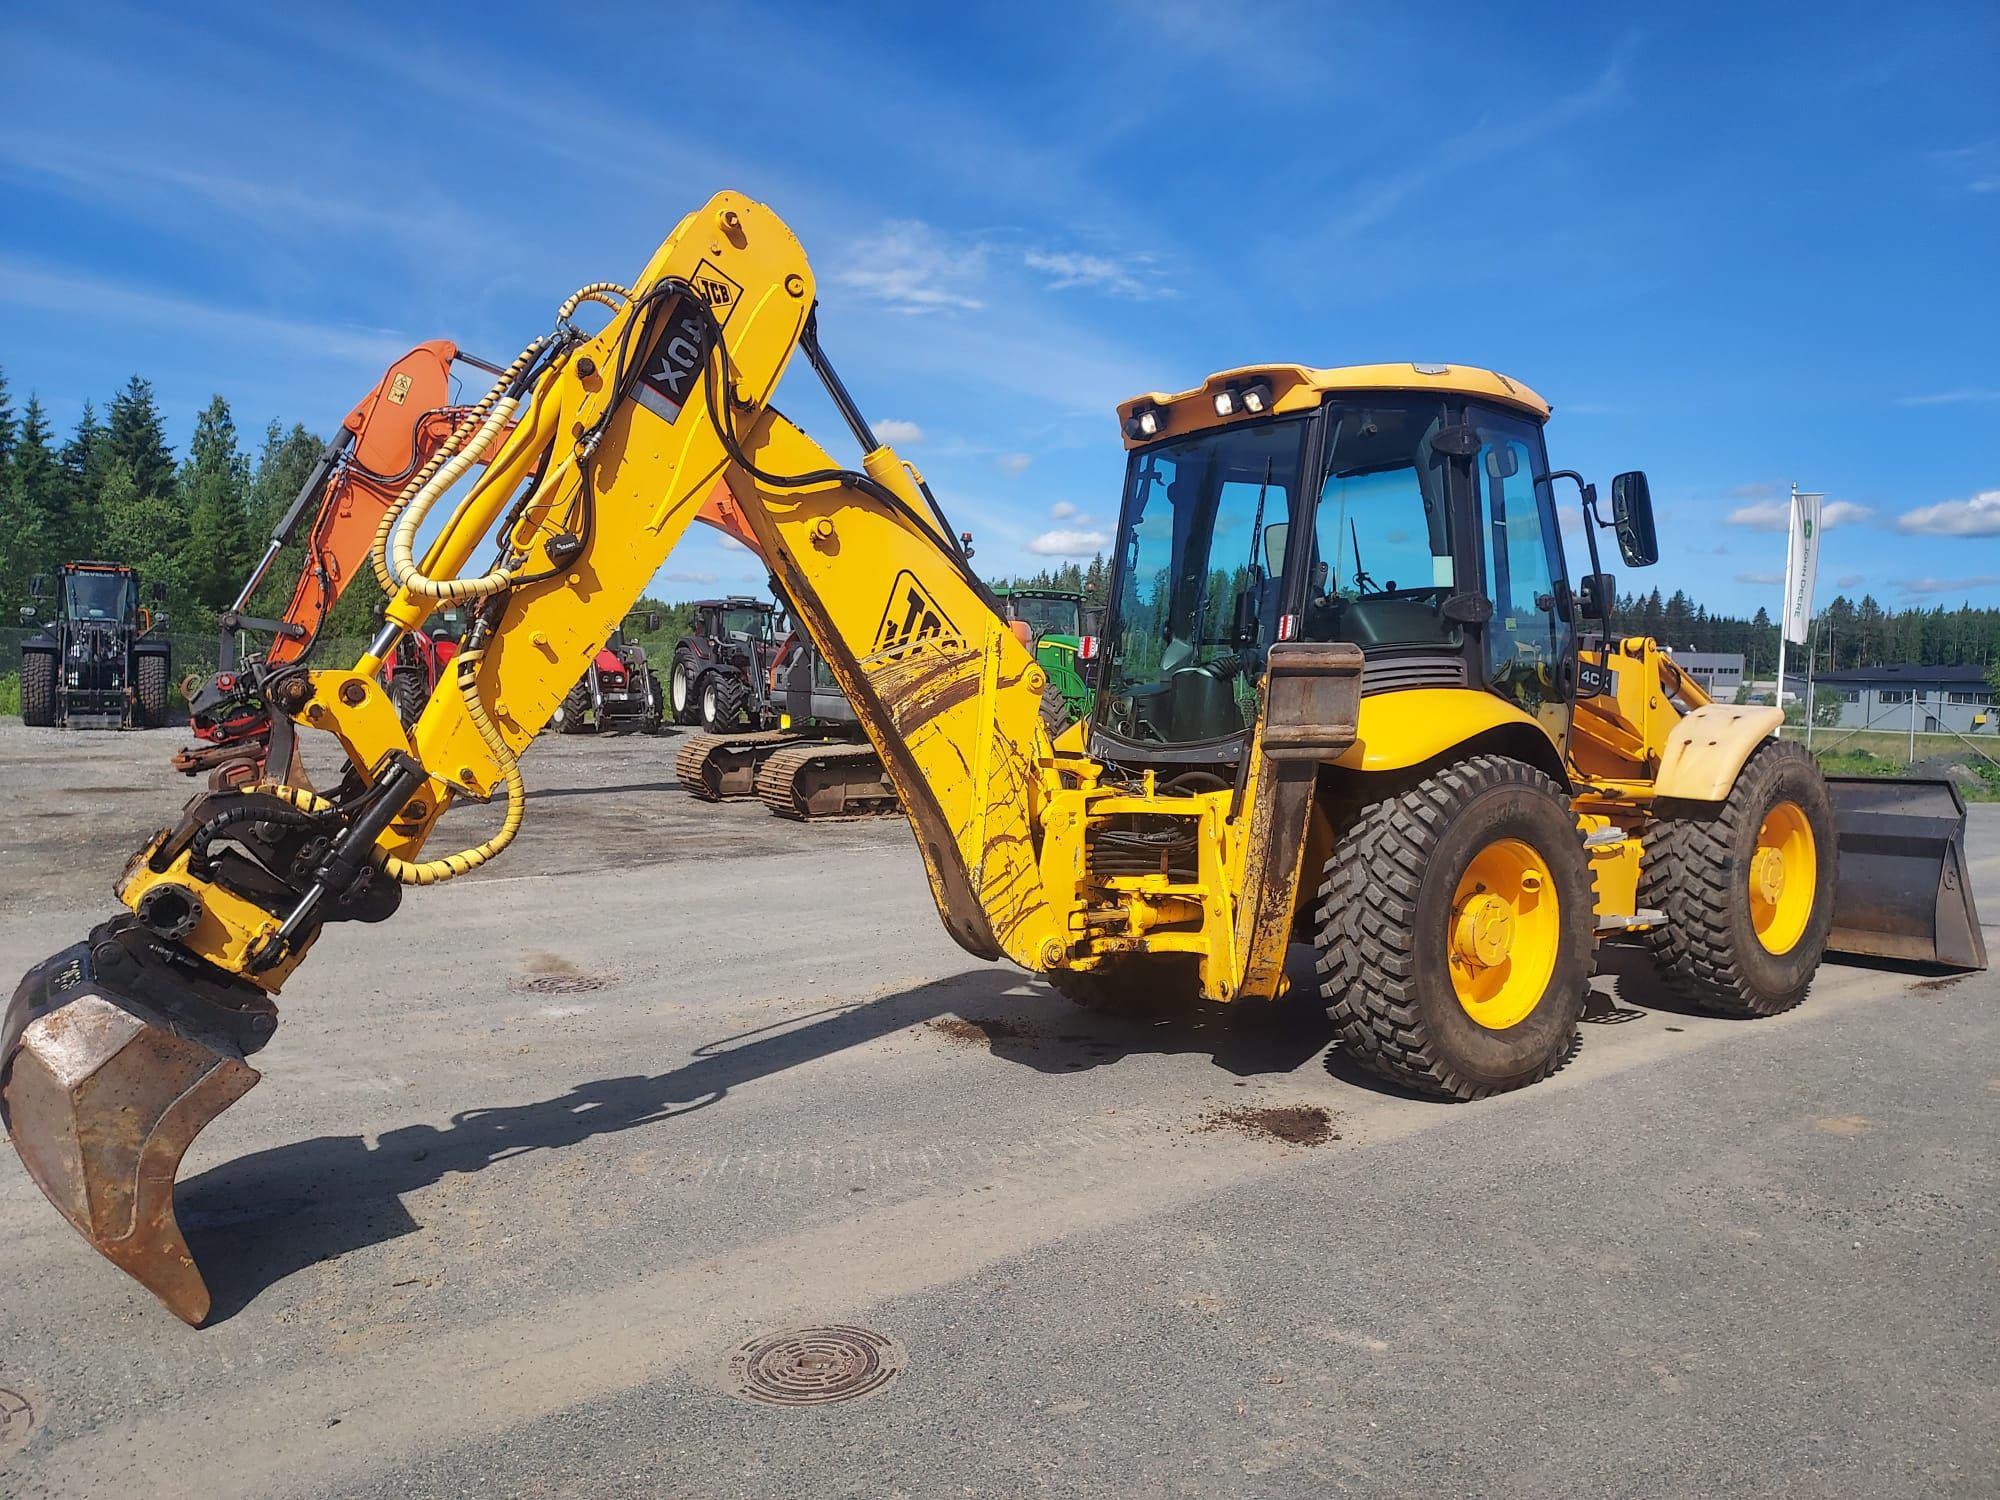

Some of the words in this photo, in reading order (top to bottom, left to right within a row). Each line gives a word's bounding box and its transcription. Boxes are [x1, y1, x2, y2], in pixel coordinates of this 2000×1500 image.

[699, 279, 730, 305] JCB
[648, 315, 707, 395] 4CX
[1801, 541, 1810, 577] JOHN
[1794, 579, 1807, 617] DEERE
